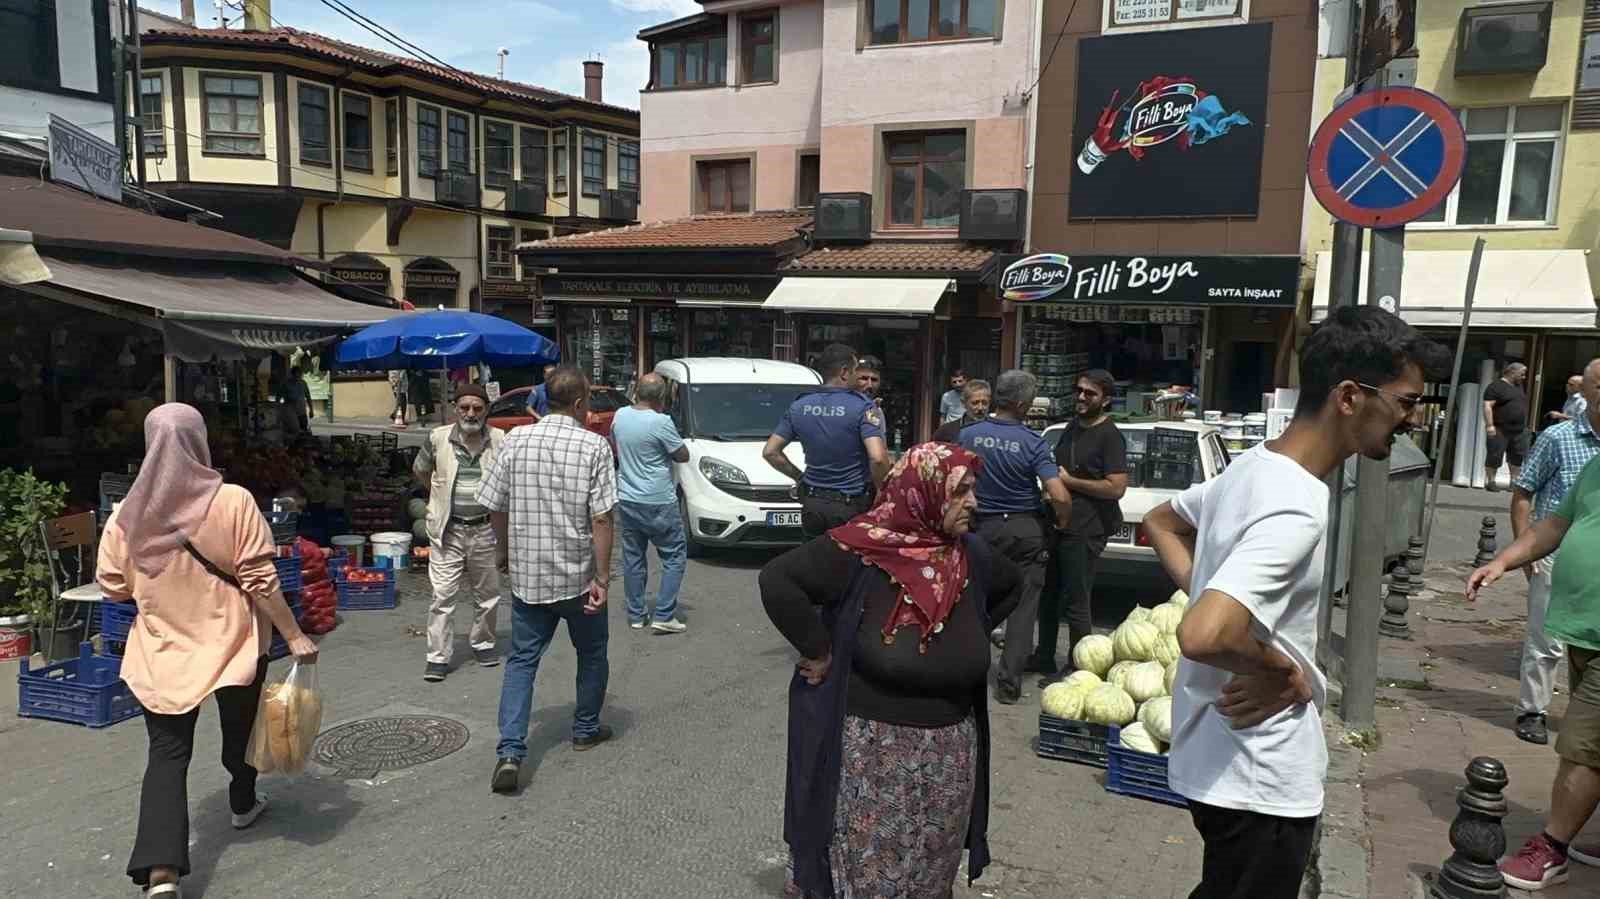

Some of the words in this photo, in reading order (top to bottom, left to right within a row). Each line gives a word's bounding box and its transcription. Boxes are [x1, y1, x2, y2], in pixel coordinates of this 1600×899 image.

[1135, 103, 1160, 130] Filli
[1163, 101, 1193, 124] Boya
[335, 270, 384, 281] TOBACCO
[1005, 268, 1031, 286] Filli
[1031, 266, 1066, 286] Boya
[1073, 260, 1121, 299] Filli
[1127, 257, 1199, 294] Boya
[1208, 287, 1242, 298] SAYTA
[1244, 287, 1283, 299] İNŞAAT
[774, 514, 785, 524] 16
